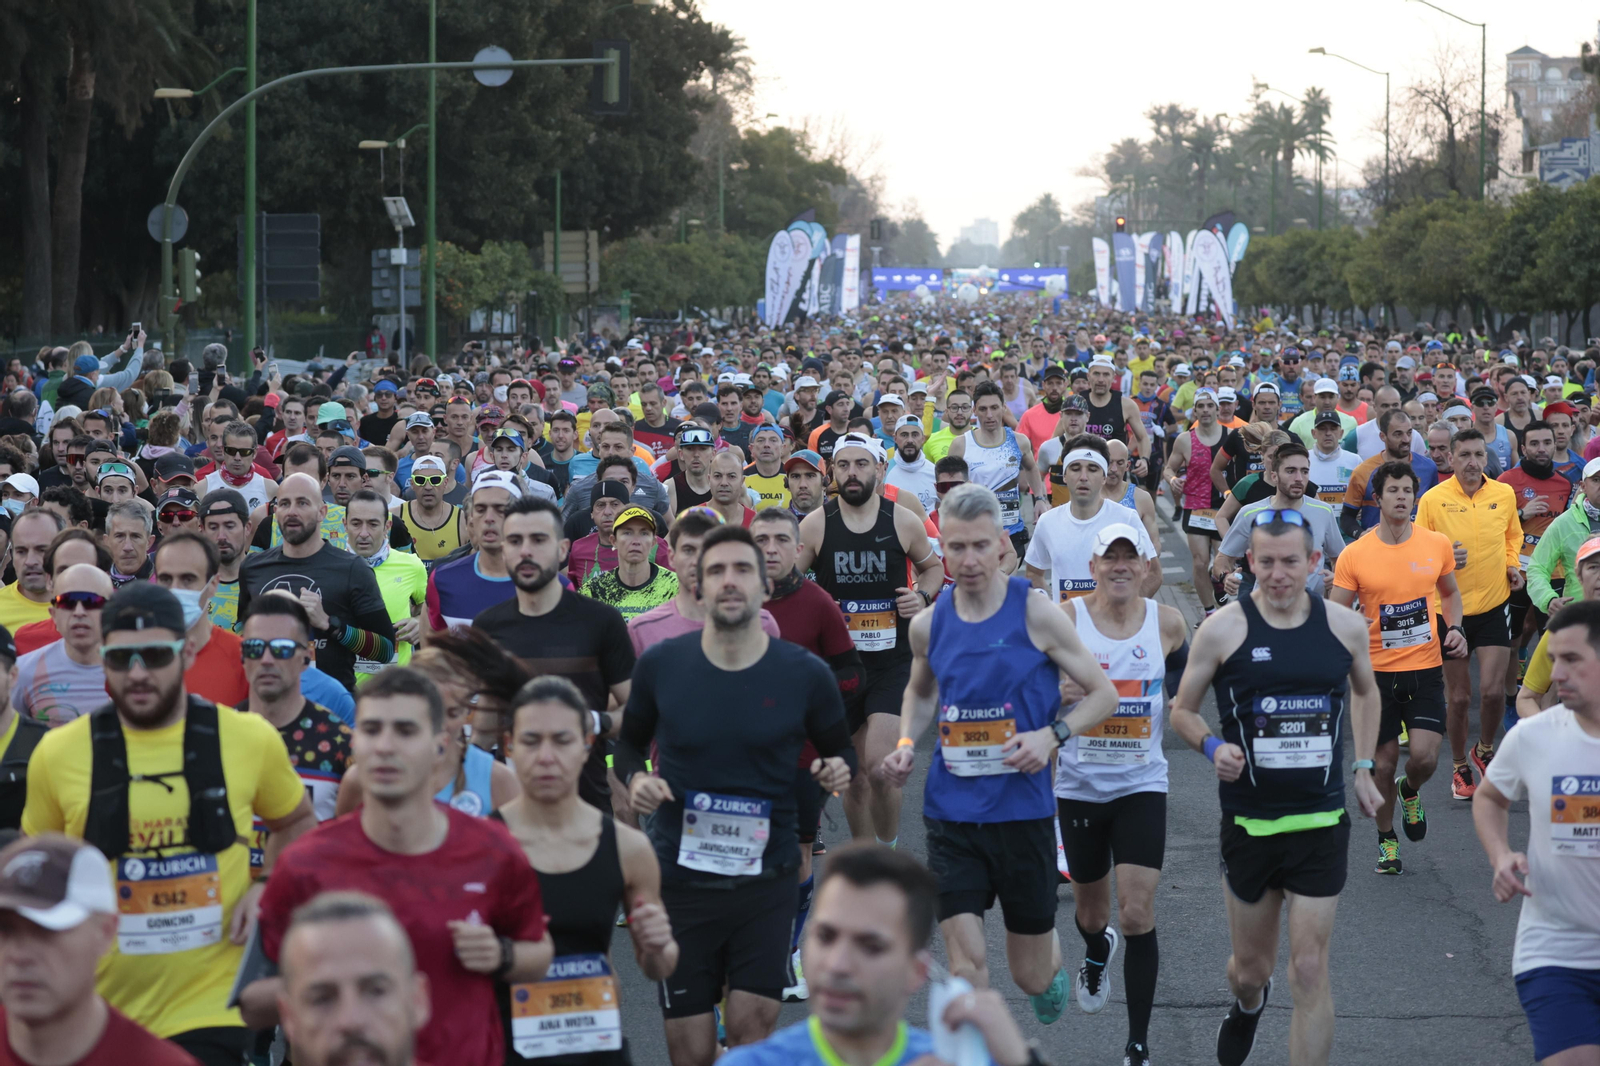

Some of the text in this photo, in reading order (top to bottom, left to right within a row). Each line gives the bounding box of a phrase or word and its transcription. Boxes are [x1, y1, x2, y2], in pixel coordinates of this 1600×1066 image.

[820, 284, 831, 314] ABC
[1086, 424, 1102, 434] TRI
[834, 550, 887, 574] RUN
[860, 602, 891, 611] ZURICH
[1396, 601, 1422, 613] ZURICH
[861, 619, 879, 627] 4171
[1397, 618, 1415, 628] 3015
[1114, 705, 1144, 714] URICH
[1279, 699, 1323, 710] ZURICH
[961, 707, 1005, 719] ZURICH
[1104, 725, 1128, 735] 5373
[1280, 722, 1306, 734] 3201
[963, 731, 989, 743] 3820
[1087, 739, 1142, 749] JOSÉ MANUEL
[1279, 740, 1310, 749] JOHN Y
[967, 749, 988, 758] MIKE
[714, 798, 762, 814] ZURICH
[711, 824, 740, 838] 8344
[148, 856, 207, 876] ZURICH
[153, 891, 187, 906] 4342
[546, 961, 603, 977] ZURICH
